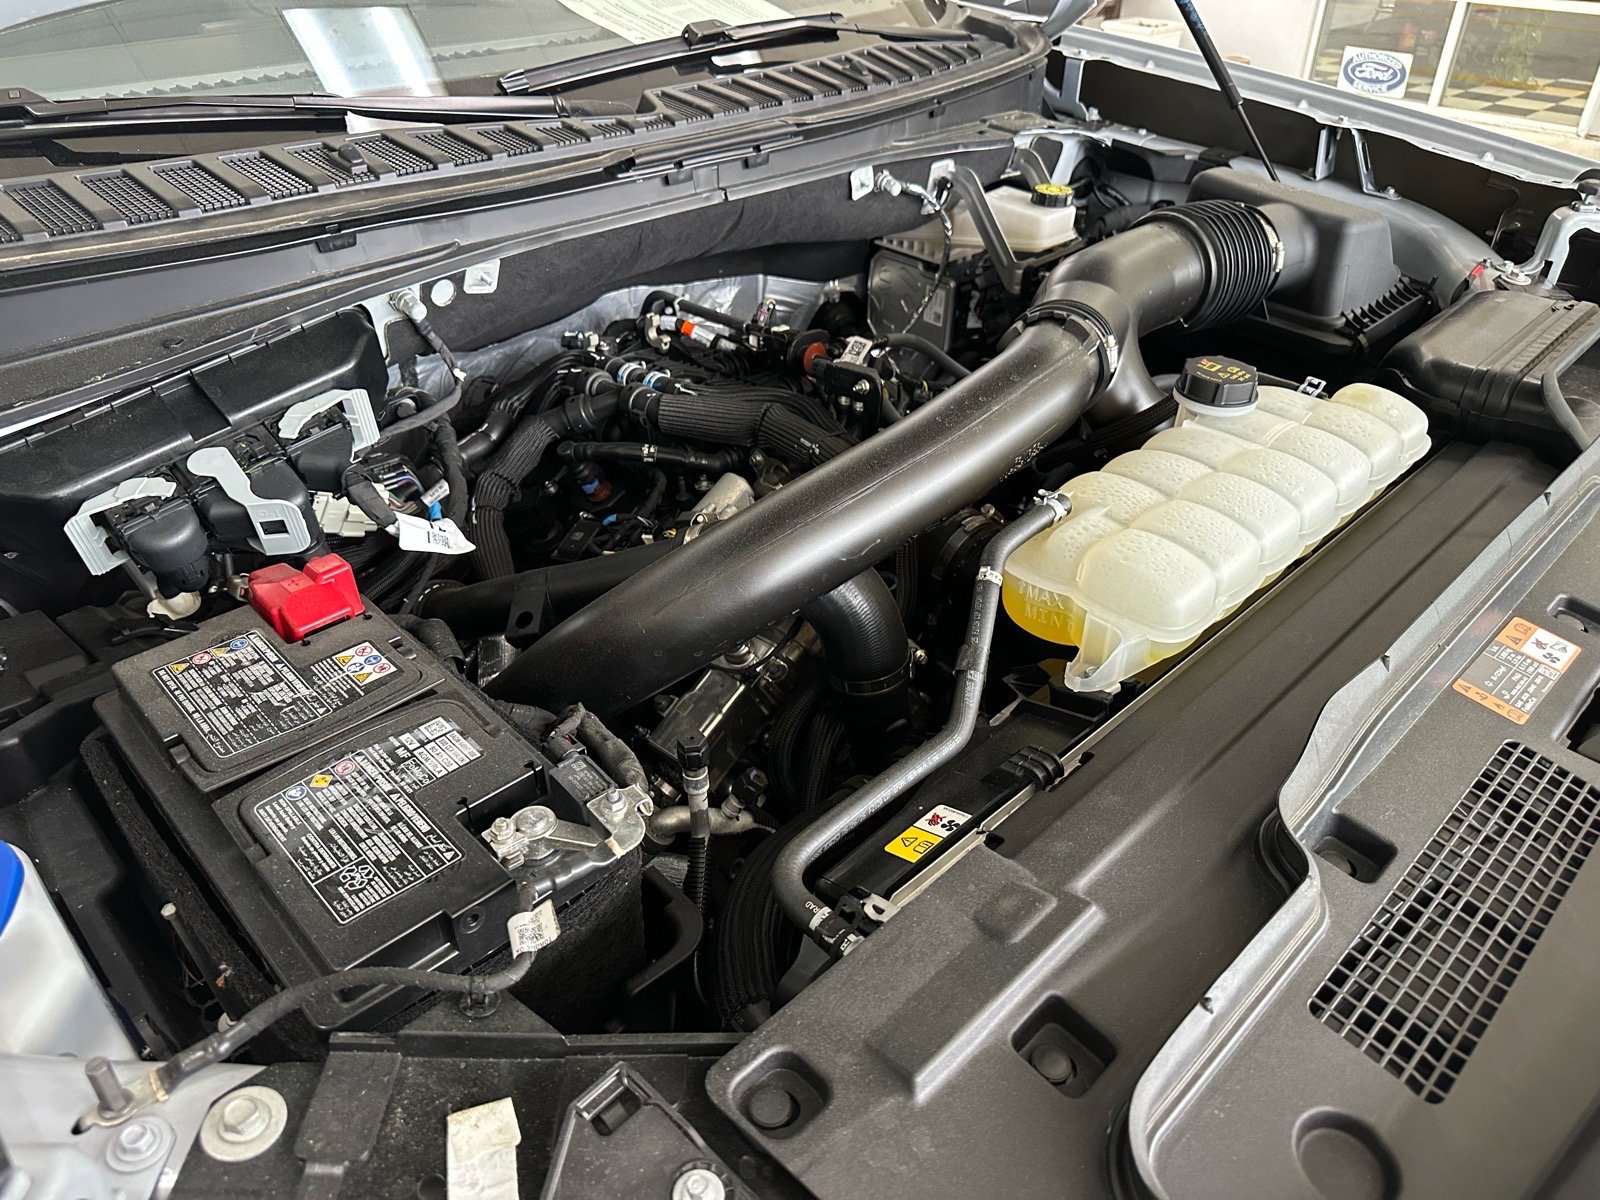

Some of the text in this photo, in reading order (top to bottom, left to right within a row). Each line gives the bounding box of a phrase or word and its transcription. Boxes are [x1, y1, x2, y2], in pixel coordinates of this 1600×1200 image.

[1355, 62, 1395, 81] Ford
[1027, 583, 1064, 609] MAX
[1025, 603, 1060, 628] MIN
[403, 760, 433, 785] FoMoCo
[805, 901, 821, 914] RAD
